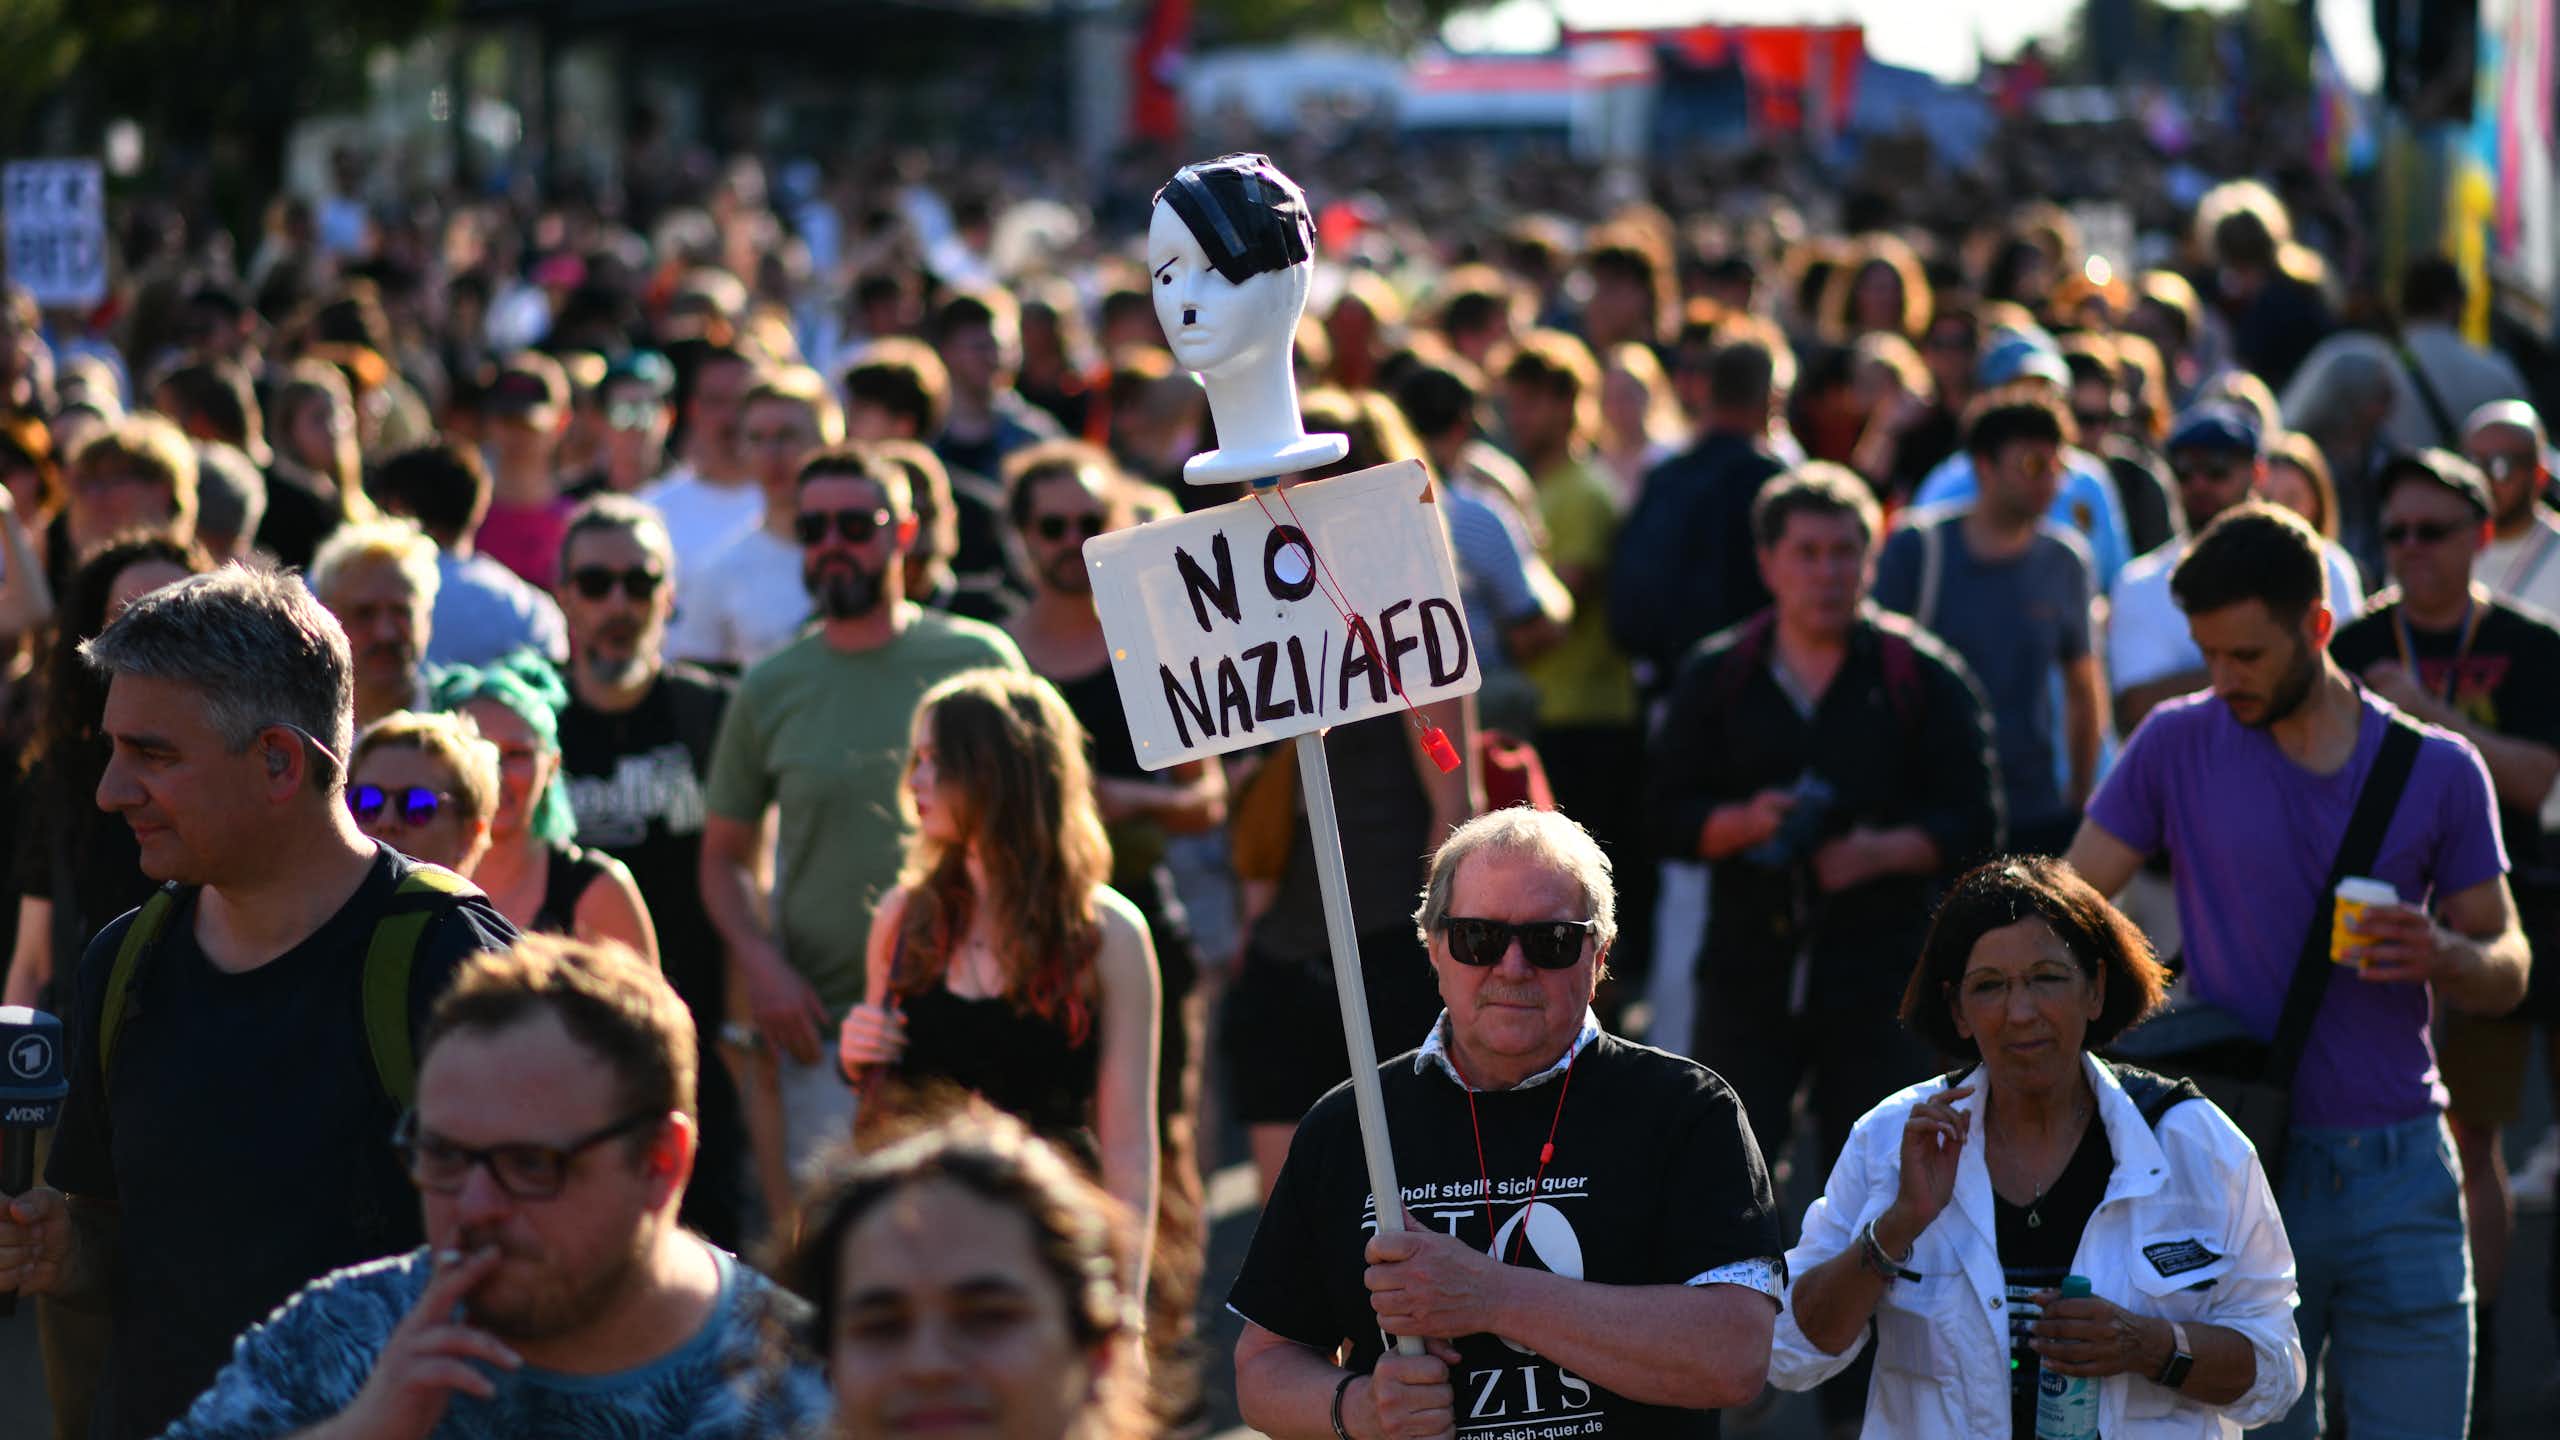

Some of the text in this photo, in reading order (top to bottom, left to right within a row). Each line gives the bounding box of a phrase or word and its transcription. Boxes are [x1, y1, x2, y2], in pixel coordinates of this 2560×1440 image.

[1174, 524, 1316, 632] NO
[1159, 598, 1469, 748] NAZI/AFD
[1364, 1174, 1588, 1209] Bholt stellt sich quer
[1469, 1364, 1592, 1418] ZIS
